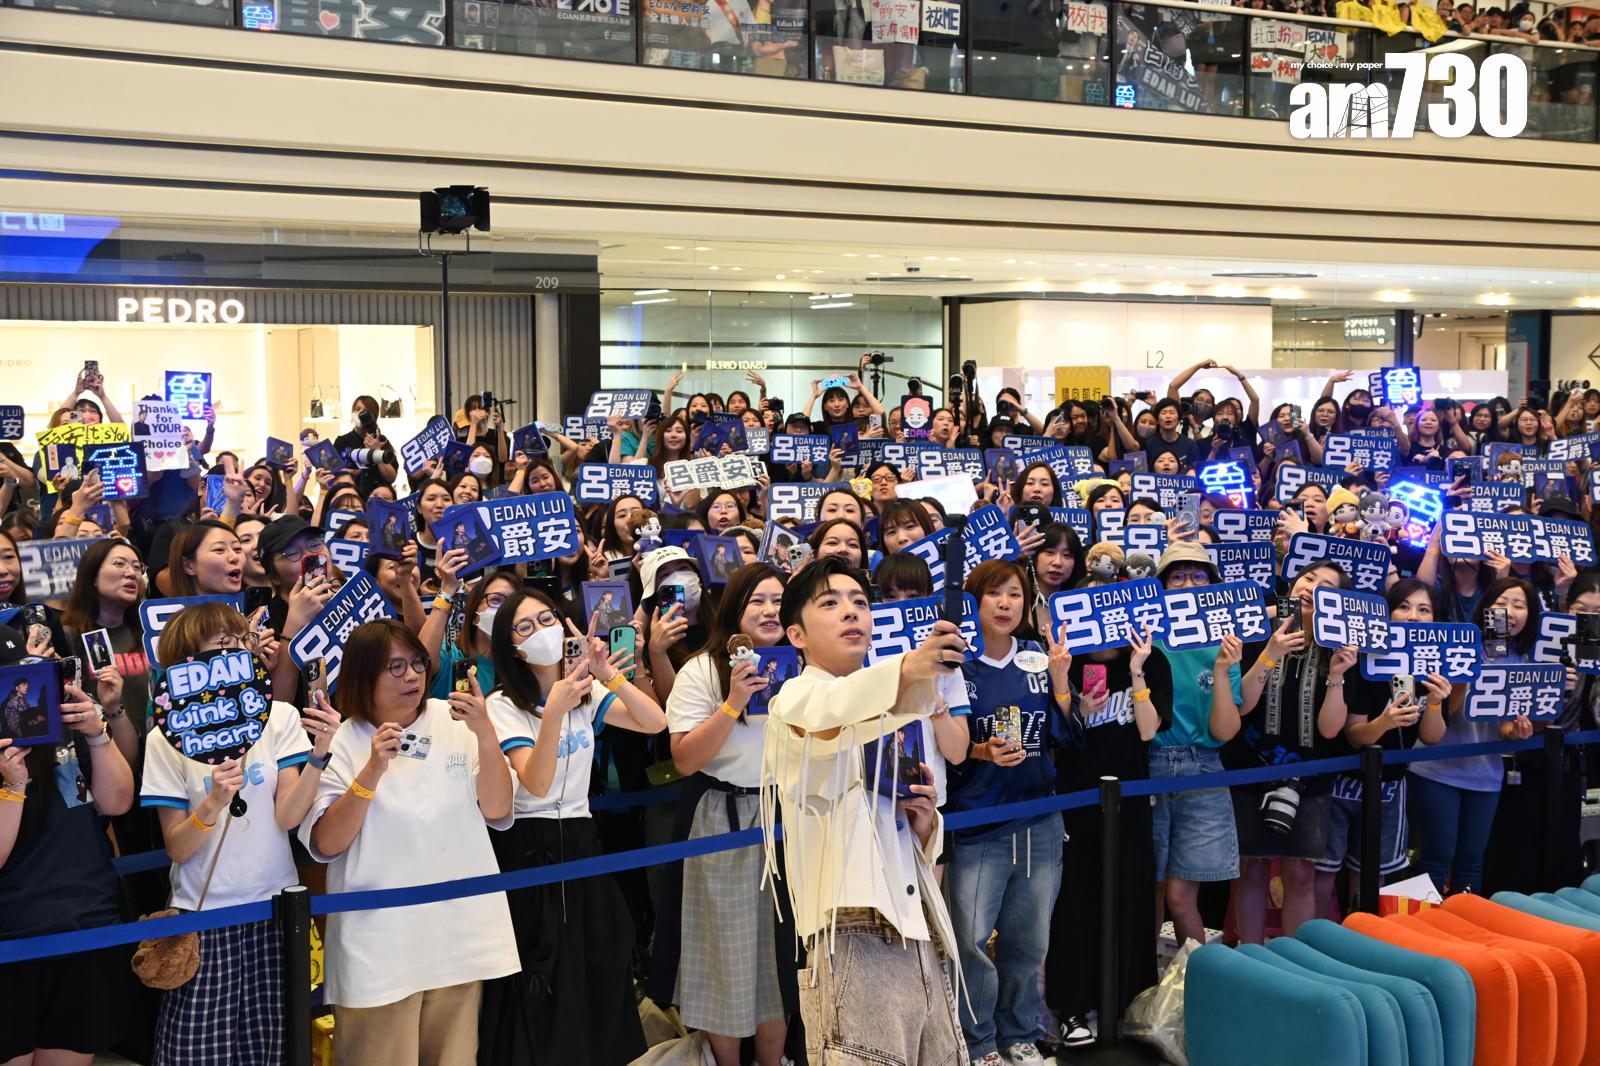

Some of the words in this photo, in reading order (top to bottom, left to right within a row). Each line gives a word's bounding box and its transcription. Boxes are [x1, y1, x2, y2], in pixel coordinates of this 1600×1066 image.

[1143, 70, 1176, 98] EDAN
[535, 276, 559, 289] 209
[117, 297, 245, 324] PEDRO
[1146, 350, 1165, 369] L2
[7, 409, 22, 418] LUI
[138, 404, 179, 414] Thanks
[588, 393, 613, 418] 呂
[152, 423, 182, 433] YOUR
[155, 413, 172, 423] for
[566, 417, 584, 440] 呂
[417, 427, 435, 445] EDAN
[434, 419, 446, 433] LUI
[903, 428, 930, 439] EDAN
[1568, 436, 1587, 446] EDAN
[773, 436, 795, 461] 呂
[1043, 439, 1055, 447] LUI
[1050, 448, 1065, 459] LUI
[1076, 449, 1089, 457] LUI
[1325, 436, 1352, 467] 呂
[1352, 438, 1376, 448] EDAN
[1378, 440, 1392, 449] LUI
[1548, 439, 1568, 460] 呂
[404, 440, 427, 474] 呂
[921, 451, 945, 480] 呂
[1522, 462, 1547, 471] EDAN
[1548, 462, 1563, 471] LUI
[580, 466, 609, 500] 呂
[609, 468, 635, 478] EDAN
[637, 468, 653, 478] LUI
[670, 459, 749, 487] 呂爵安
[1157, 478, 1180, 488] EDAN
[1181, 480, 1195, 489] LUI
[1307, 472, 1333, 483] EDAN
[801, 487, 823, 495] EDAN
[1471, 486, 1499, 497] EDAN
[1503, 487, 1521, 497] LUI
[494, 503, 538, 522] EDAN
[541, 499, 567, 514] LUI
[978, 510, 1000, 531] LUI
[1071, 513, 1088, 524] LUI
[1248, 516, 1279, 527] EDAN
[1477, 518, 1507, 532] EDAN
[1510, 519, 1530, 533] LUI
[1545, 523, 1570, 537] EDAN
[1572, 526, 1589, 538] LUI
[500, 517, 573, 559] 爵安
[1445, 513, 1482, 556] 呂
[1220, 548, 1250, 561] EDAN
[1254, 547, 1271, 560] LUI
[1328, 542, 1364, 558] EDAN
[1365, 547, 1387, 563] LUI
[322, 599, 353, 633] EDAN
[352, 580, 373, 601] LUI
[1094, 589, 1132, 608] EDAN
[1136, 584, 1158, 600] LUI
[1198, 589, 1236, 608] EDAN
[1238, 586, 1259, 602] LUI
[1318, 590, 1347, 645] 呂
[1343, 598, 1370, 614] EDAN
[1370, 601, 1386, 616] LUI
[1054, 593, 1102, 650] 呂
[1165, 592, 1208, 648] 呂
[1205, 604, 1266, 642] 爵安
[1348, 614, 1389, 651] 爵安
[1409, 628, 1448, 643] EDAN
[1452, 630, 1475, 643] LUI
[1411, 644, 1477, 677] 爵安
[168, 651, 254, 700] EDAN
[1026, 672, 1049, 694] 02
[1508, 671, 1540, 683] EDAN
[1543, 671, 1562, 683] LUI
[1469, 669, 1507, 718] 呂
[1507, 684, 1561, 716] 爵安
[168, 699, 239, 731] wink
[240, 688, 266, 716] &
[184, 722, 262, 757] heart
